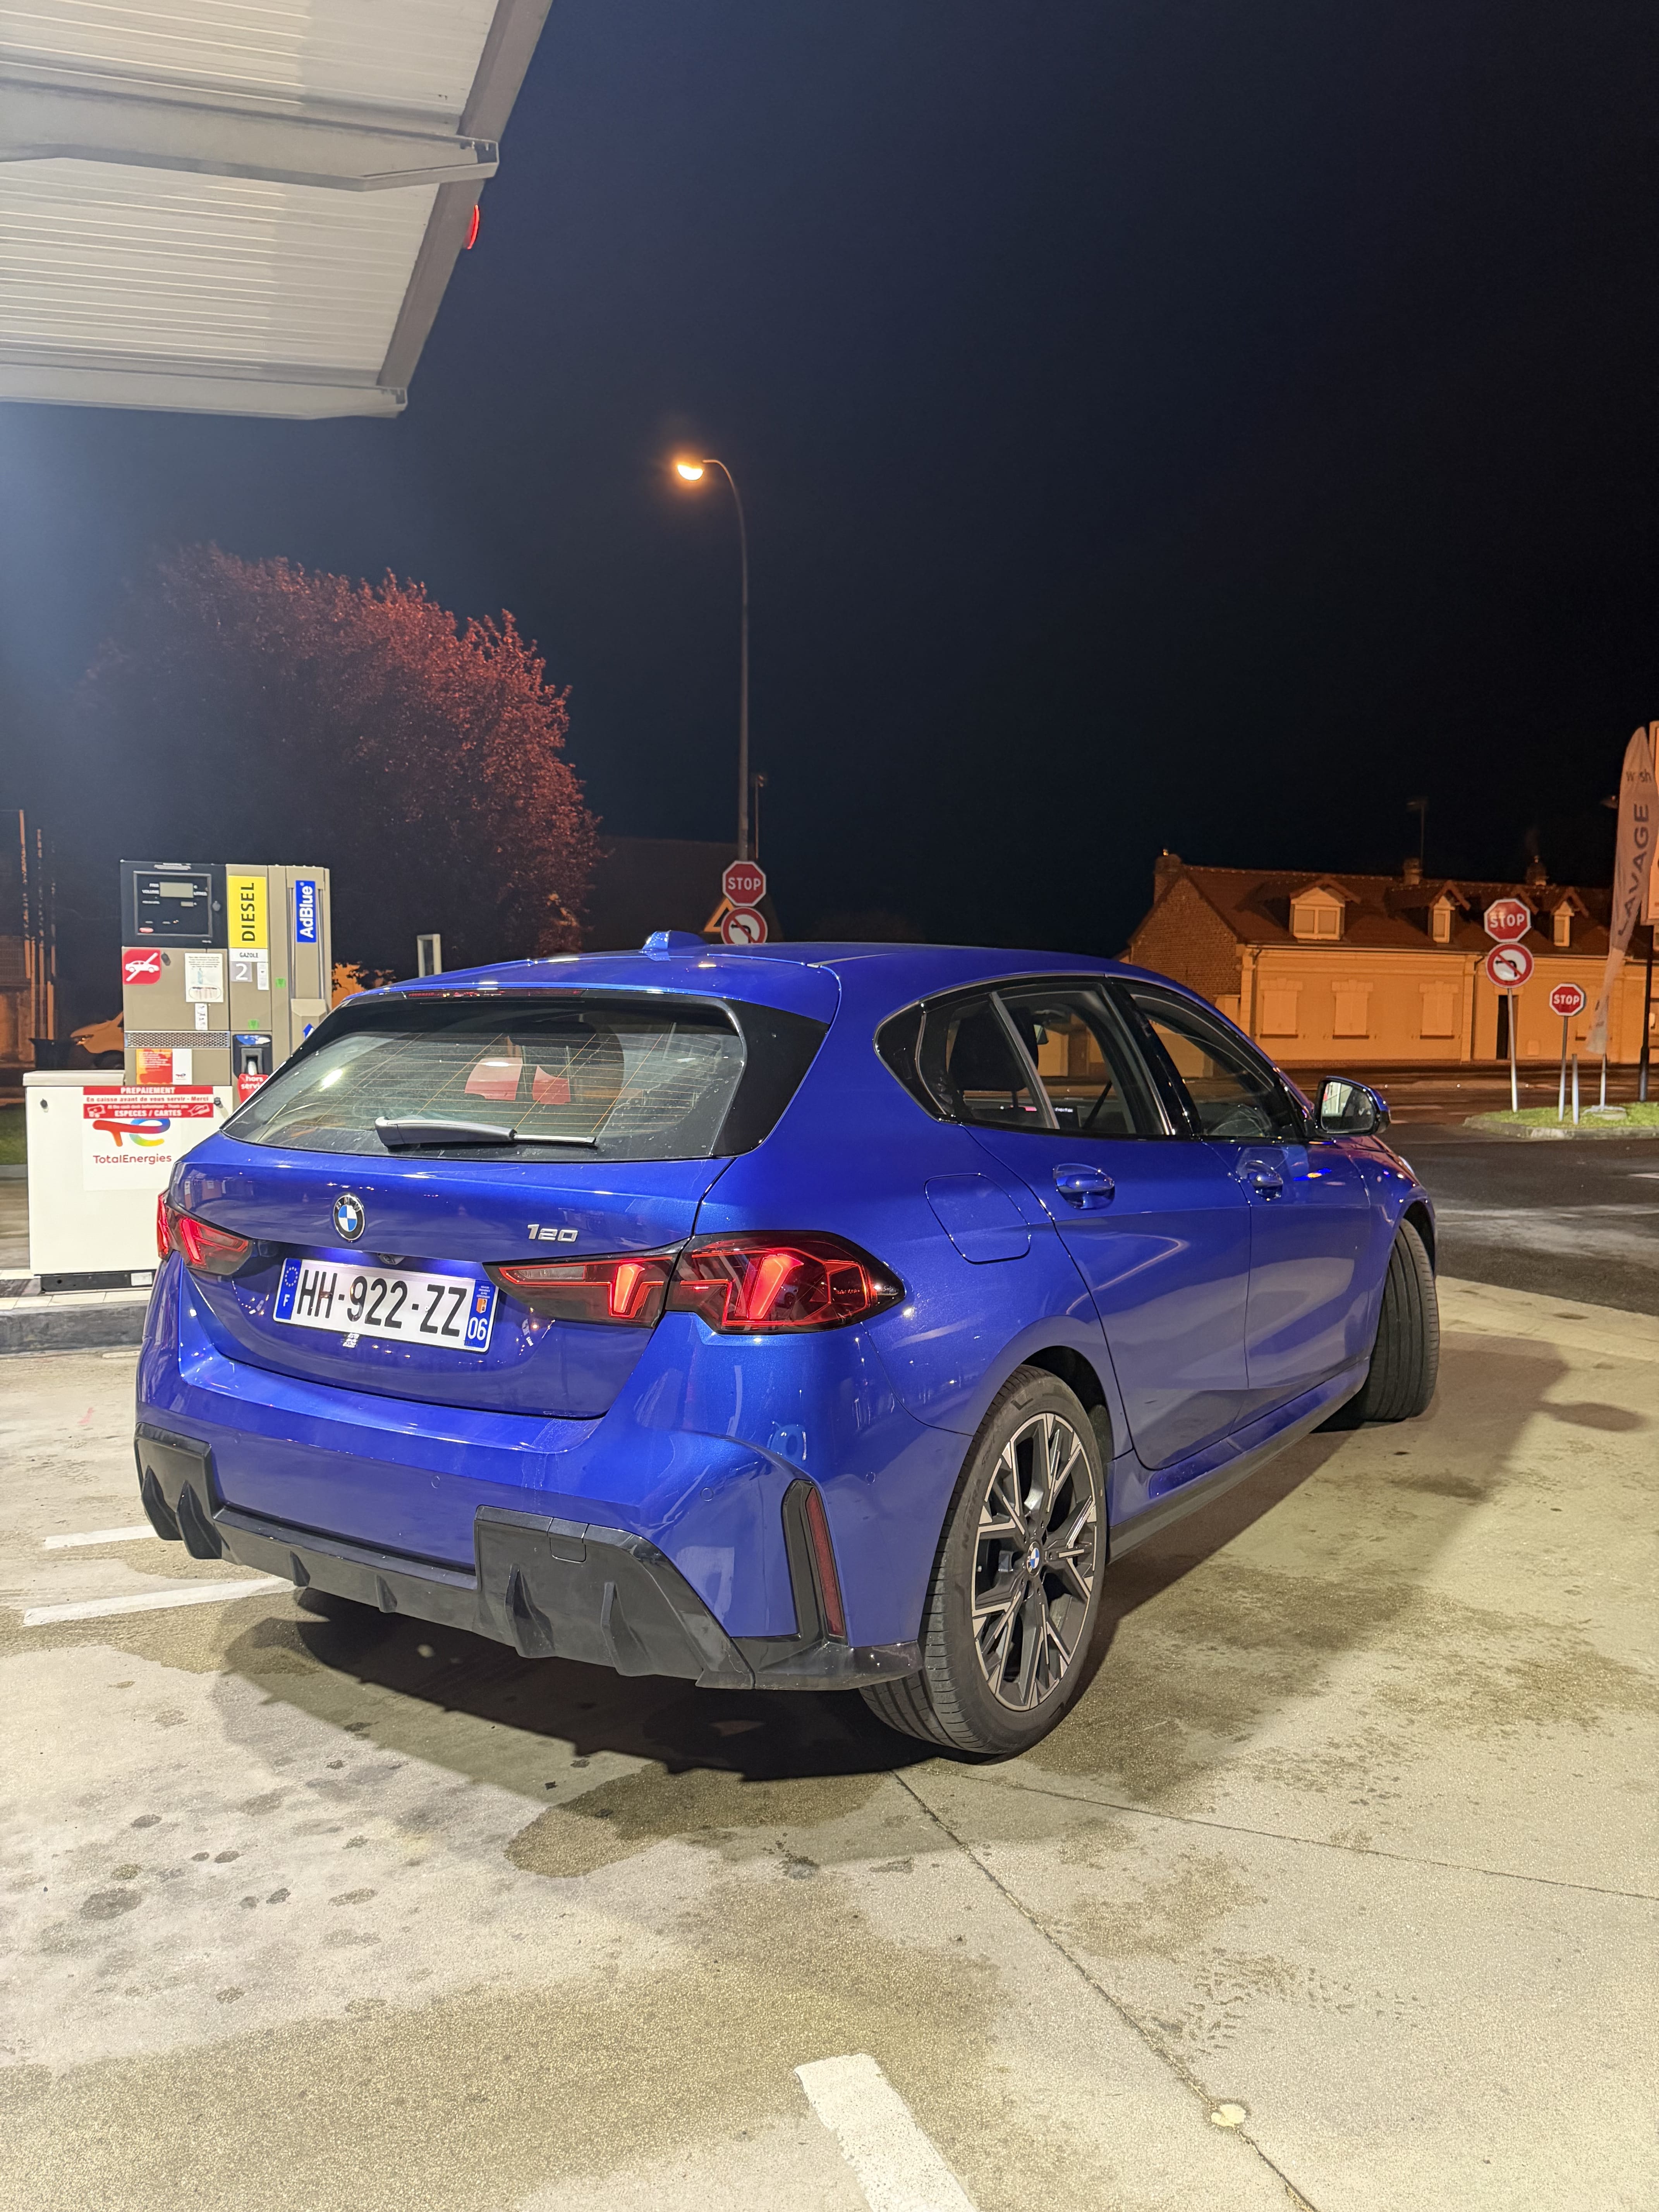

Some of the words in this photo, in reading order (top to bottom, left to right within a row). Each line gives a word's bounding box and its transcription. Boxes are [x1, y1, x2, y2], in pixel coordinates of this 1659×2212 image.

[728, 877, 761, 890] STOP
[240, 883, 255, 941] DIESEL
[299, 886, 314, 938] AdBlue
[1489, 912, 1525, 929] STOP
[235, 963, 248, 981] 2
[1553, 994, 1580, 1005] STOP
[93, 1154, 172, 1164] TotalEnergies
[527, 1224, 578, 1242] 120
[283, 1294, 290, 1307] F
[297, 1269, 467, 1337] HH-922-ZZ
[467, 1317, 488, 1341] 06
